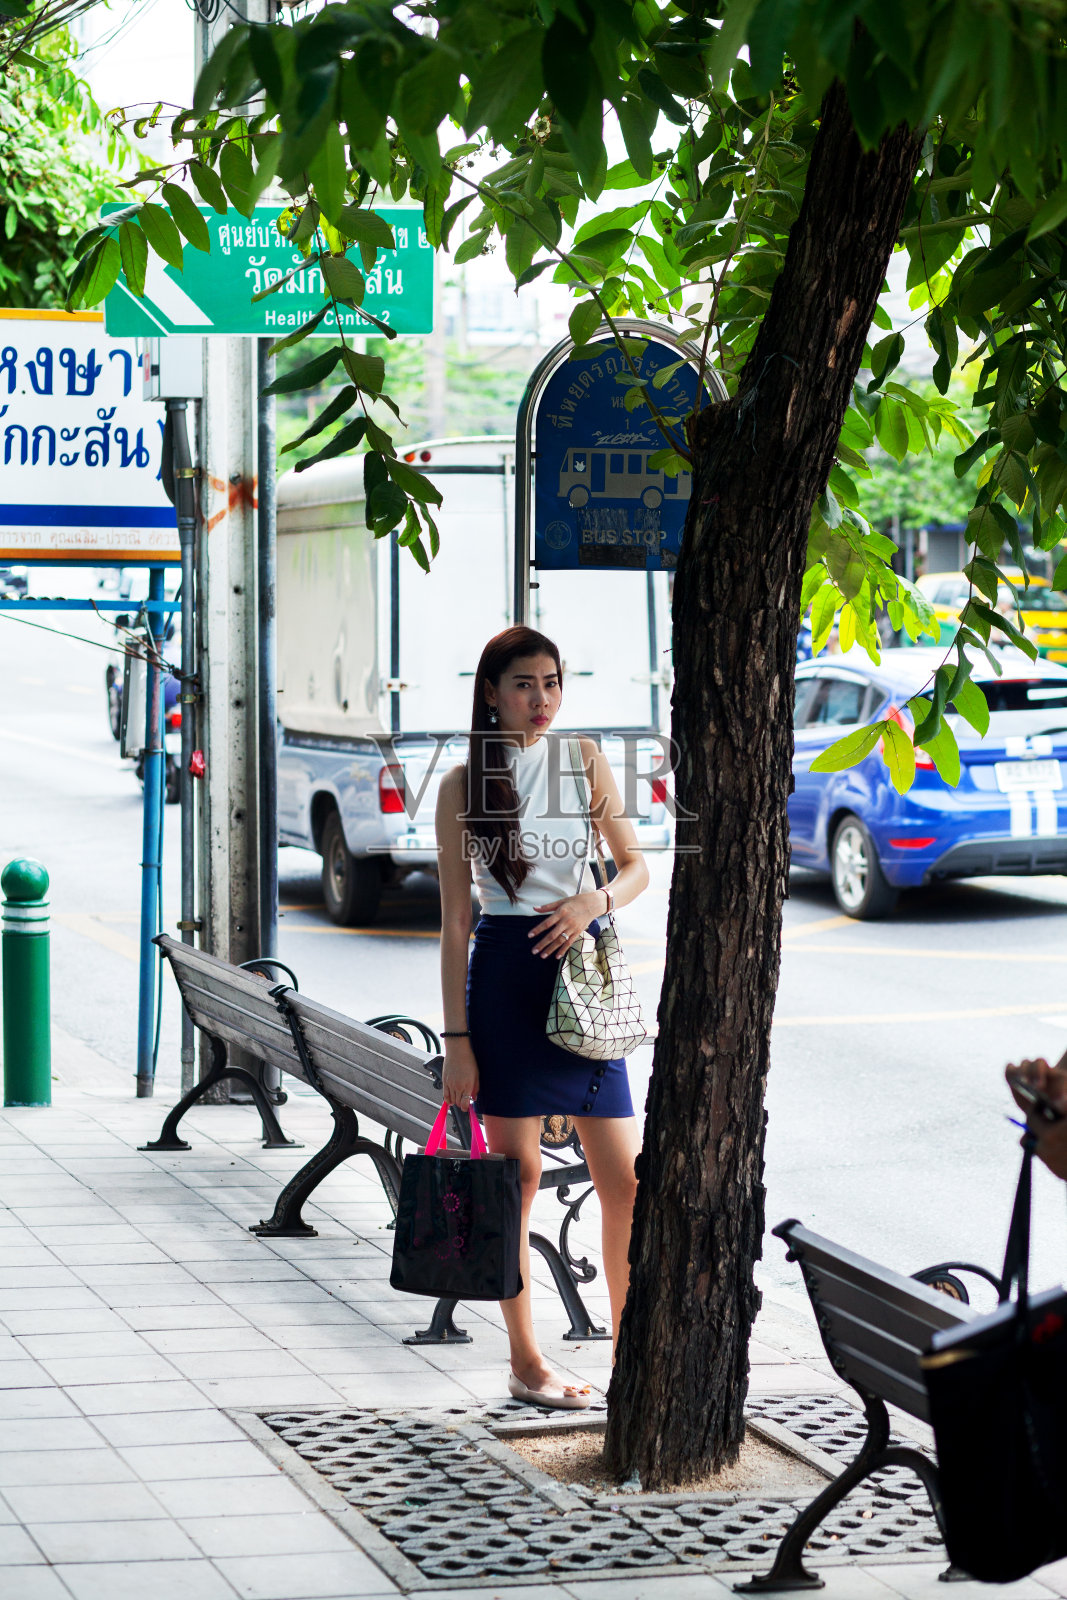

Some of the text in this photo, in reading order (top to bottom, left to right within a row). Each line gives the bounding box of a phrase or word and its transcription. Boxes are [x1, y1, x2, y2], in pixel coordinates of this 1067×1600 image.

[245, 255, 403, 294] วัดมักสัน
[323, 310, 377, 325] Cente
[381, 310, 391, 325] 2
[582, 530, 616, 545] BUS
[622, 530, 667, 545] STOP
